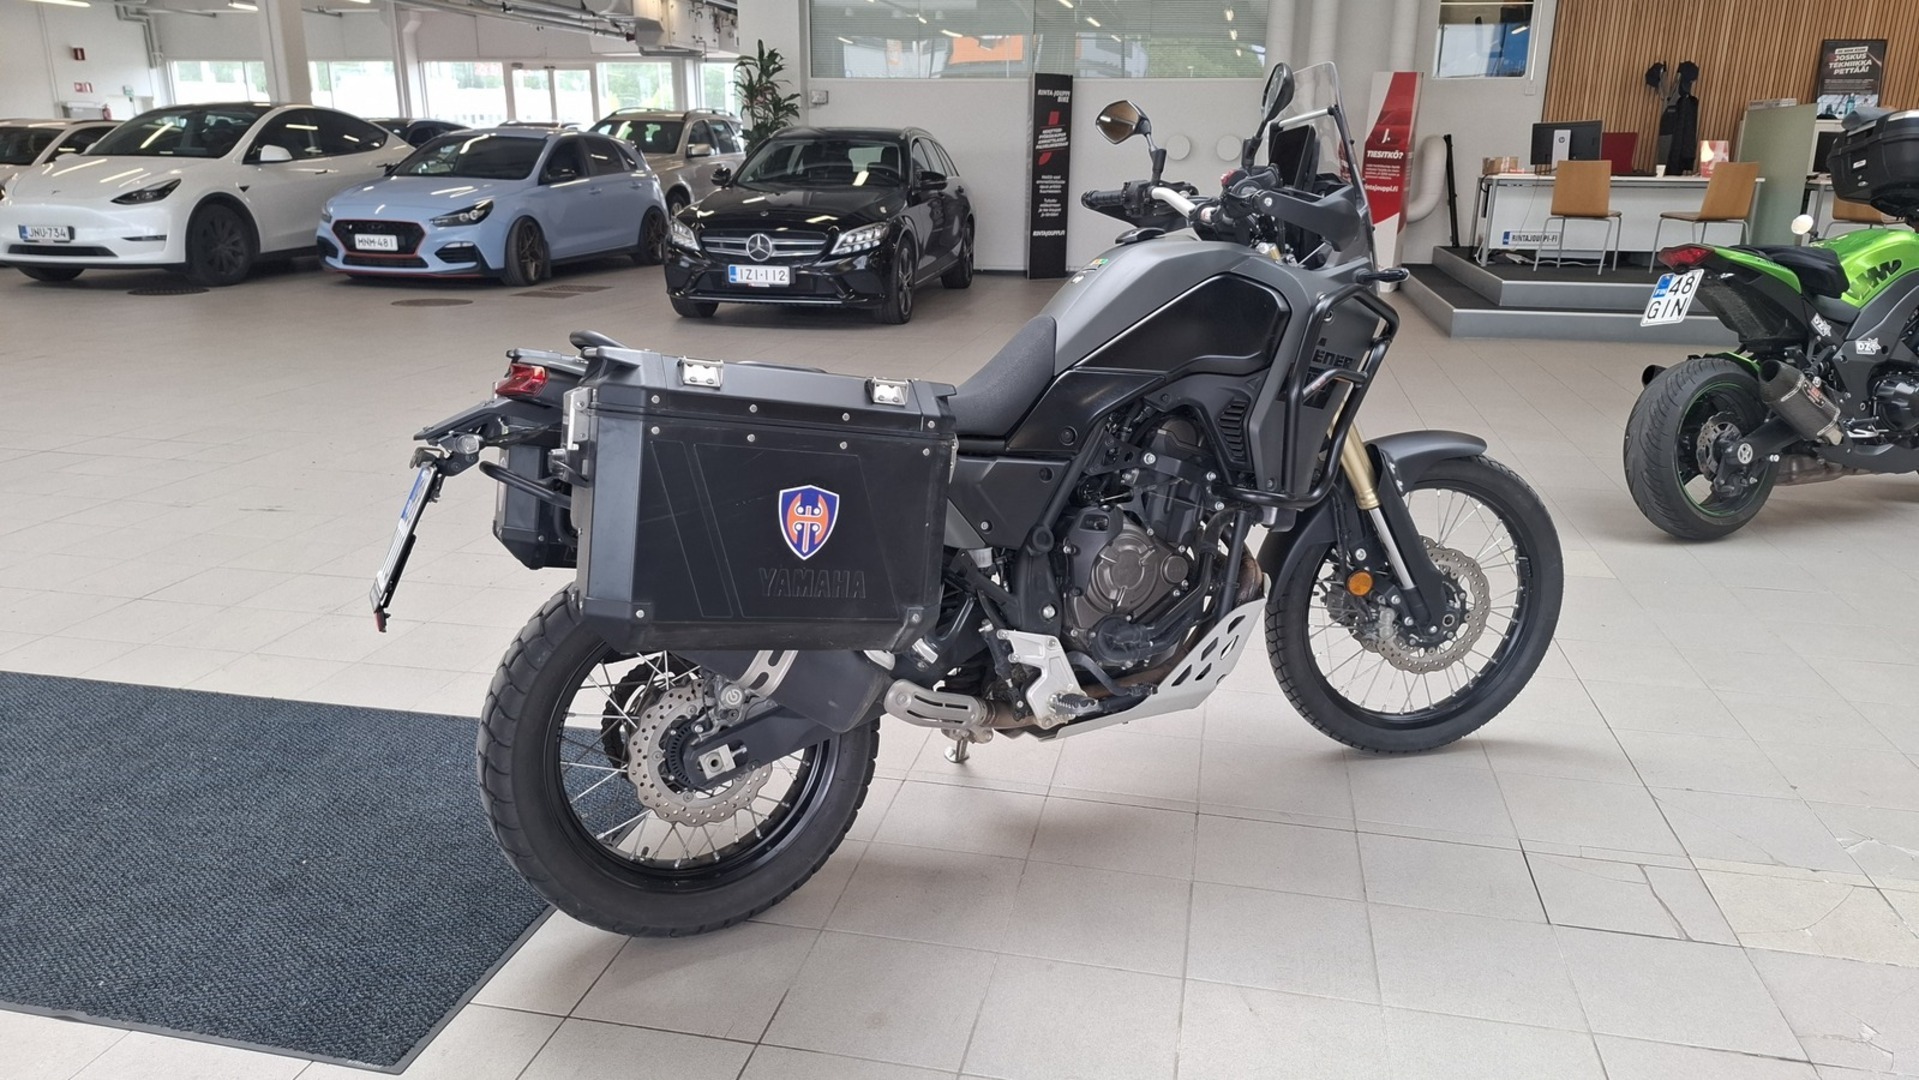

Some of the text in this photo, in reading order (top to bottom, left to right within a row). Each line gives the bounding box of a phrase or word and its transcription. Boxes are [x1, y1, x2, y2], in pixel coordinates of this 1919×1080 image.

[1835, 53, 1867, 62] JOSKUS
[1829, 59, 1872, 69] TEKNIIKKA
[1366, 150, 1404, 159] TIESITKÖ?
[1364, 184, 1399, 193] intajouppi.fi
[739, 268, 786, 282] IZI-112
[1668, 275, 1695, 296] 48
[1647, 297, 1688, 320] GIN
[759, 567, 866, 599] YAMAHA
